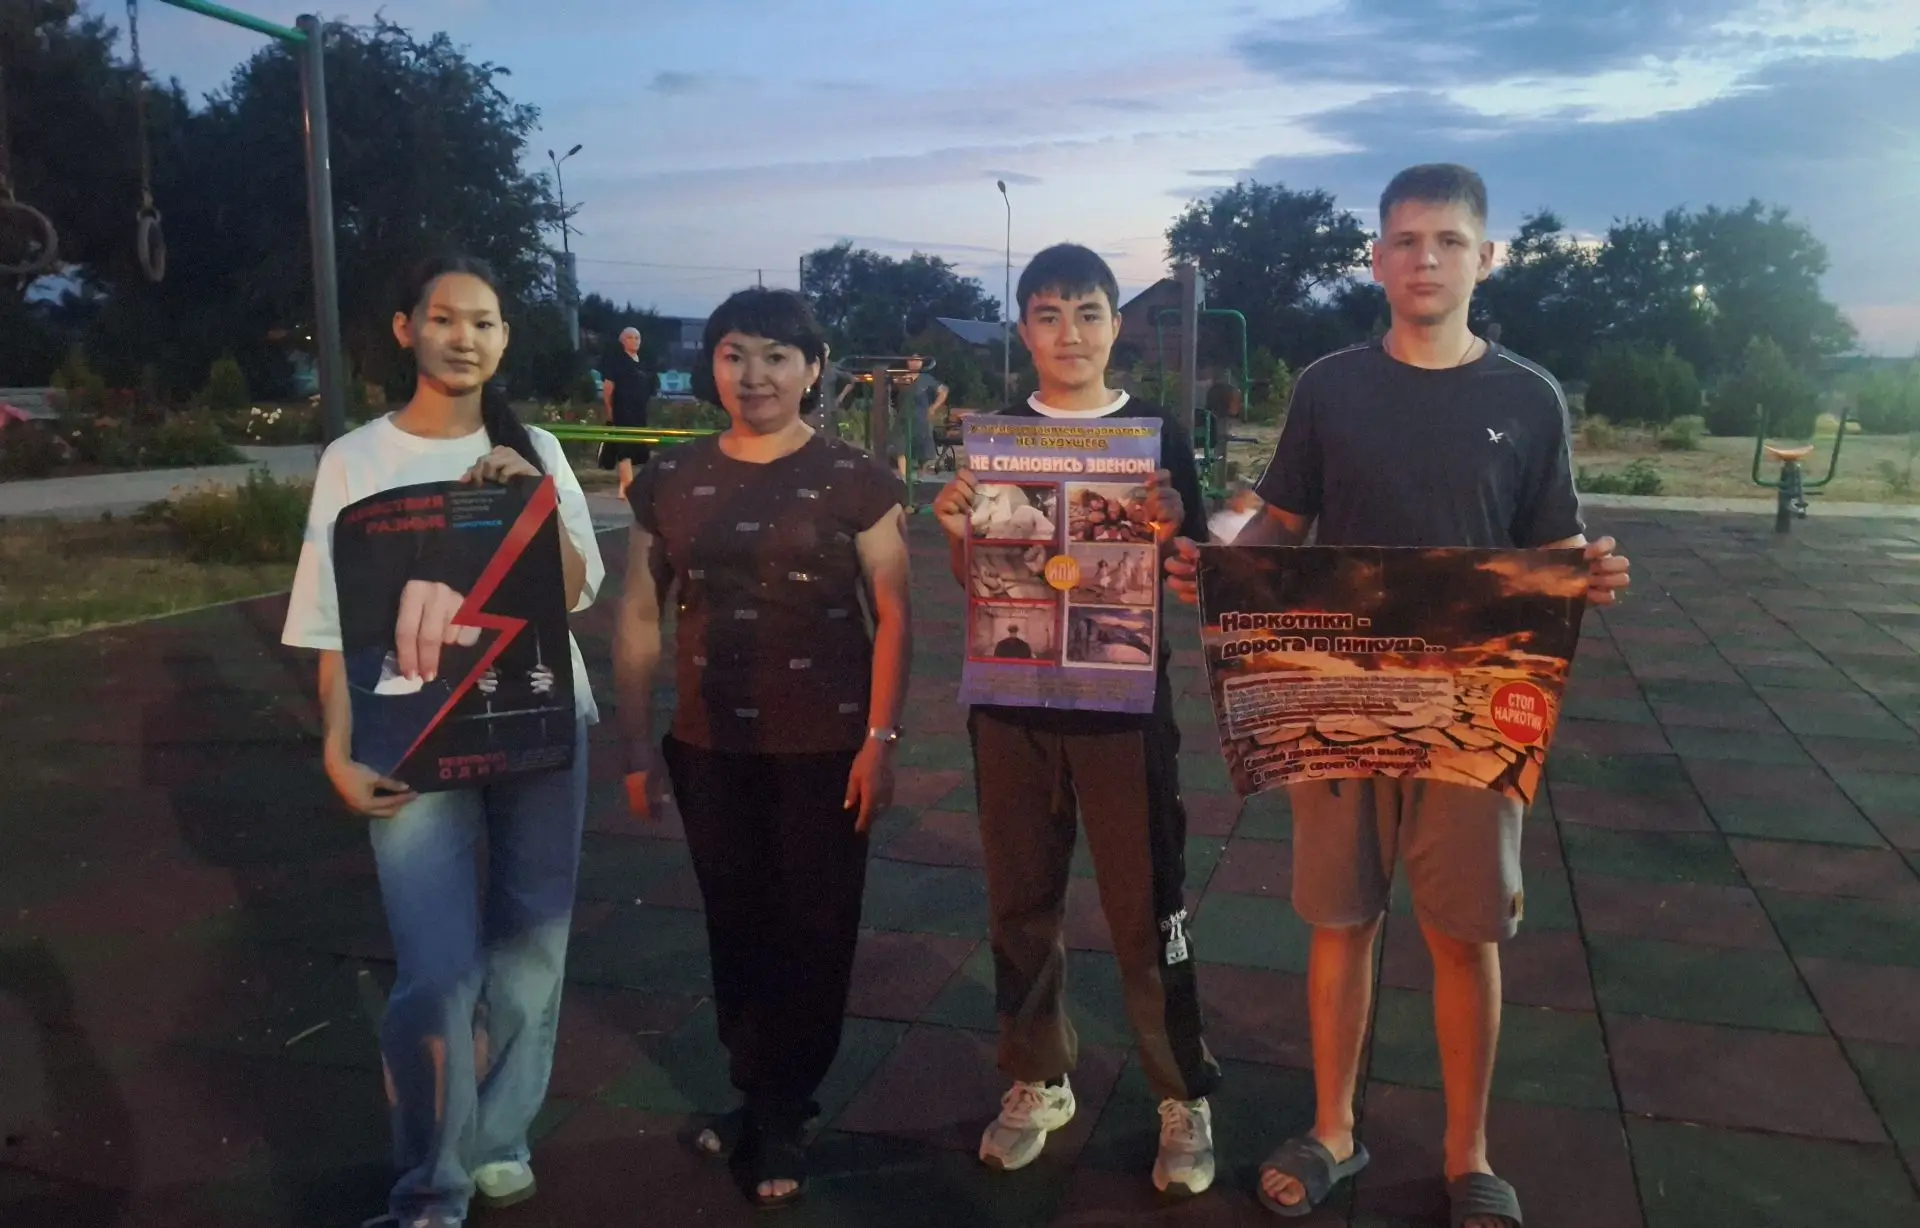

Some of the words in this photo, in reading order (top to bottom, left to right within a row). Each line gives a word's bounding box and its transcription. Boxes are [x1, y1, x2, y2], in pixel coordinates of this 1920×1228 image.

[969, 455, 990, 471] НЕ
[992, 456, 1083, 473] СТАНОВИСЬ
[1085, 457, 1156, 474] ЗВЕНОМ!
[1220, 611, 1352, 633] Наркотики
[1222, 637, 1307, 659] дорога
[1312, 637, 1330, 653] в
[1335, 637, 1446, 653] никуда...
[1508, 692, 1534, 712] СТОП
[1495, 706, 1543, 731] НАРКОТИК
